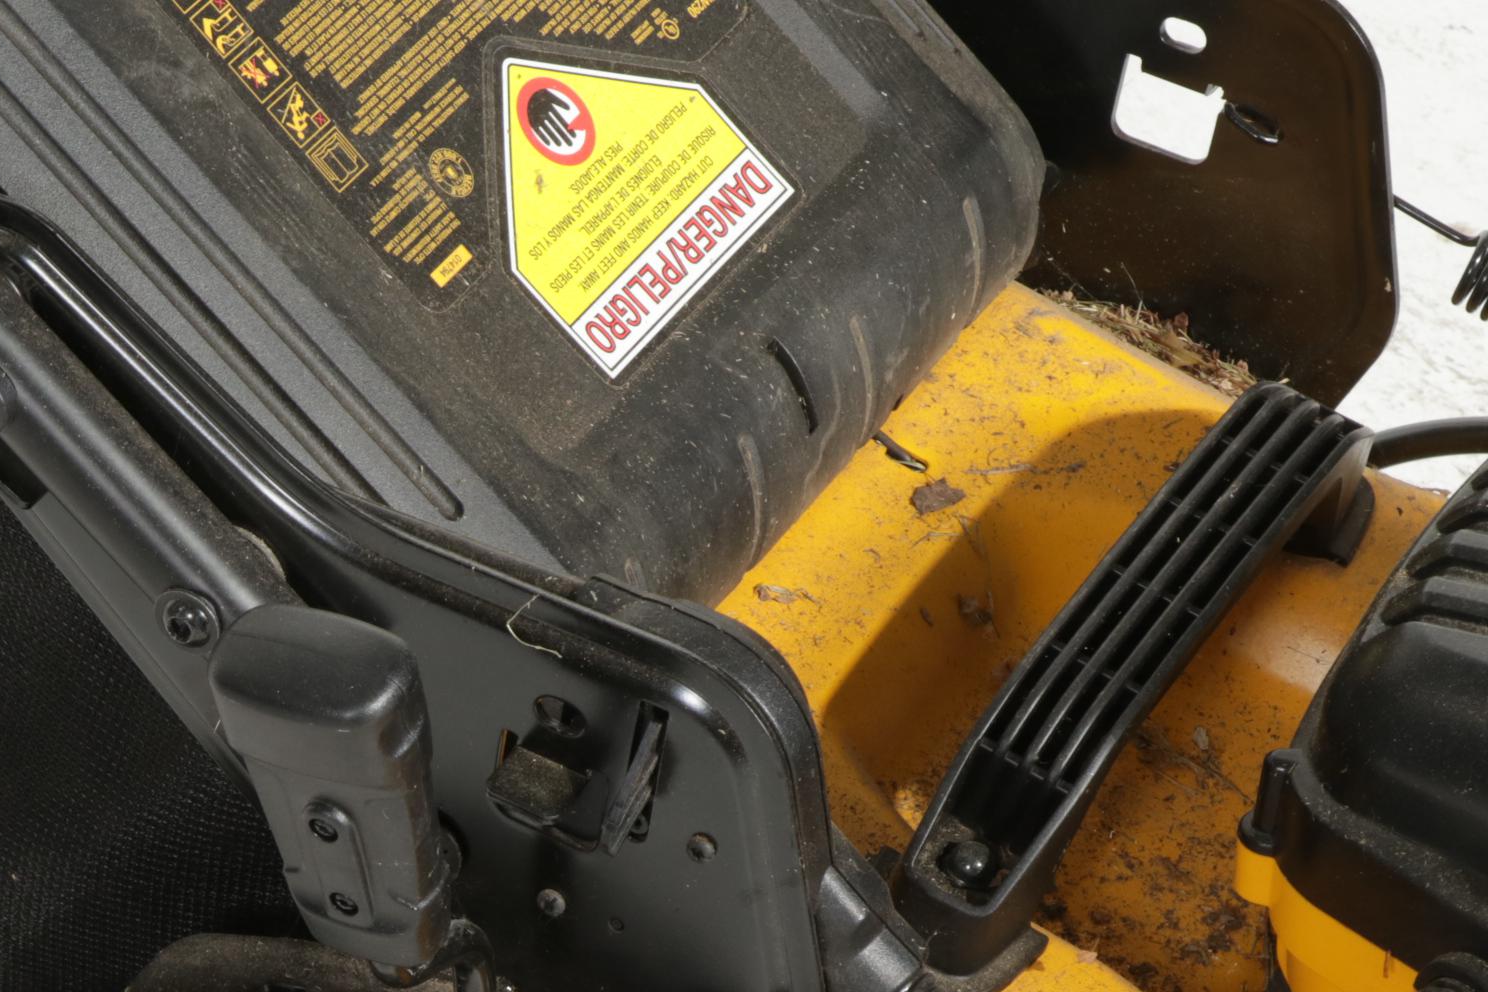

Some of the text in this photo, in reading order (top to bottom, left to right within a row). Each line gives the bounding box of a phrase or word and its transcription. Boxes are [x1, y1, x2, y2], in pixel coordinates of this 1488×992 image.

[655, 100, 687, 135] PELIGRO
[644, 128, 659, 144] DE
[686, 123, 716, 154] RISQUE
[603, 139, 623, 162] PIES
[676, 148, 691, 165] DE
[695, 153, 714, 174] CUT
[584, 162, 625, 205] MANTENGA
[615, 185, 630, 201] DE
[571, 198, 589, 218] LAS
[624, 191, 649, 217] TENIR
[649, 196, 671, 221] KEEP
[547, 211, 576, 242] MANOS
[611, 210, 629, 230] LES
[625, 214, 654, 244] HANDS
[541, 236, 552, 247] Y
[589, 224, 616, 252] MAINS
[611, 236, 631, 258] AND
[527, 240, 546, 261] LOS
[580, 245, 595, 261] ET
[582, 158, 773, 357] DANGER/PELIGRO
[567, 254, 586, 274] LES
[595, 251, 616, 274] FEET
[548, 267, 573, 293] PIEDS
